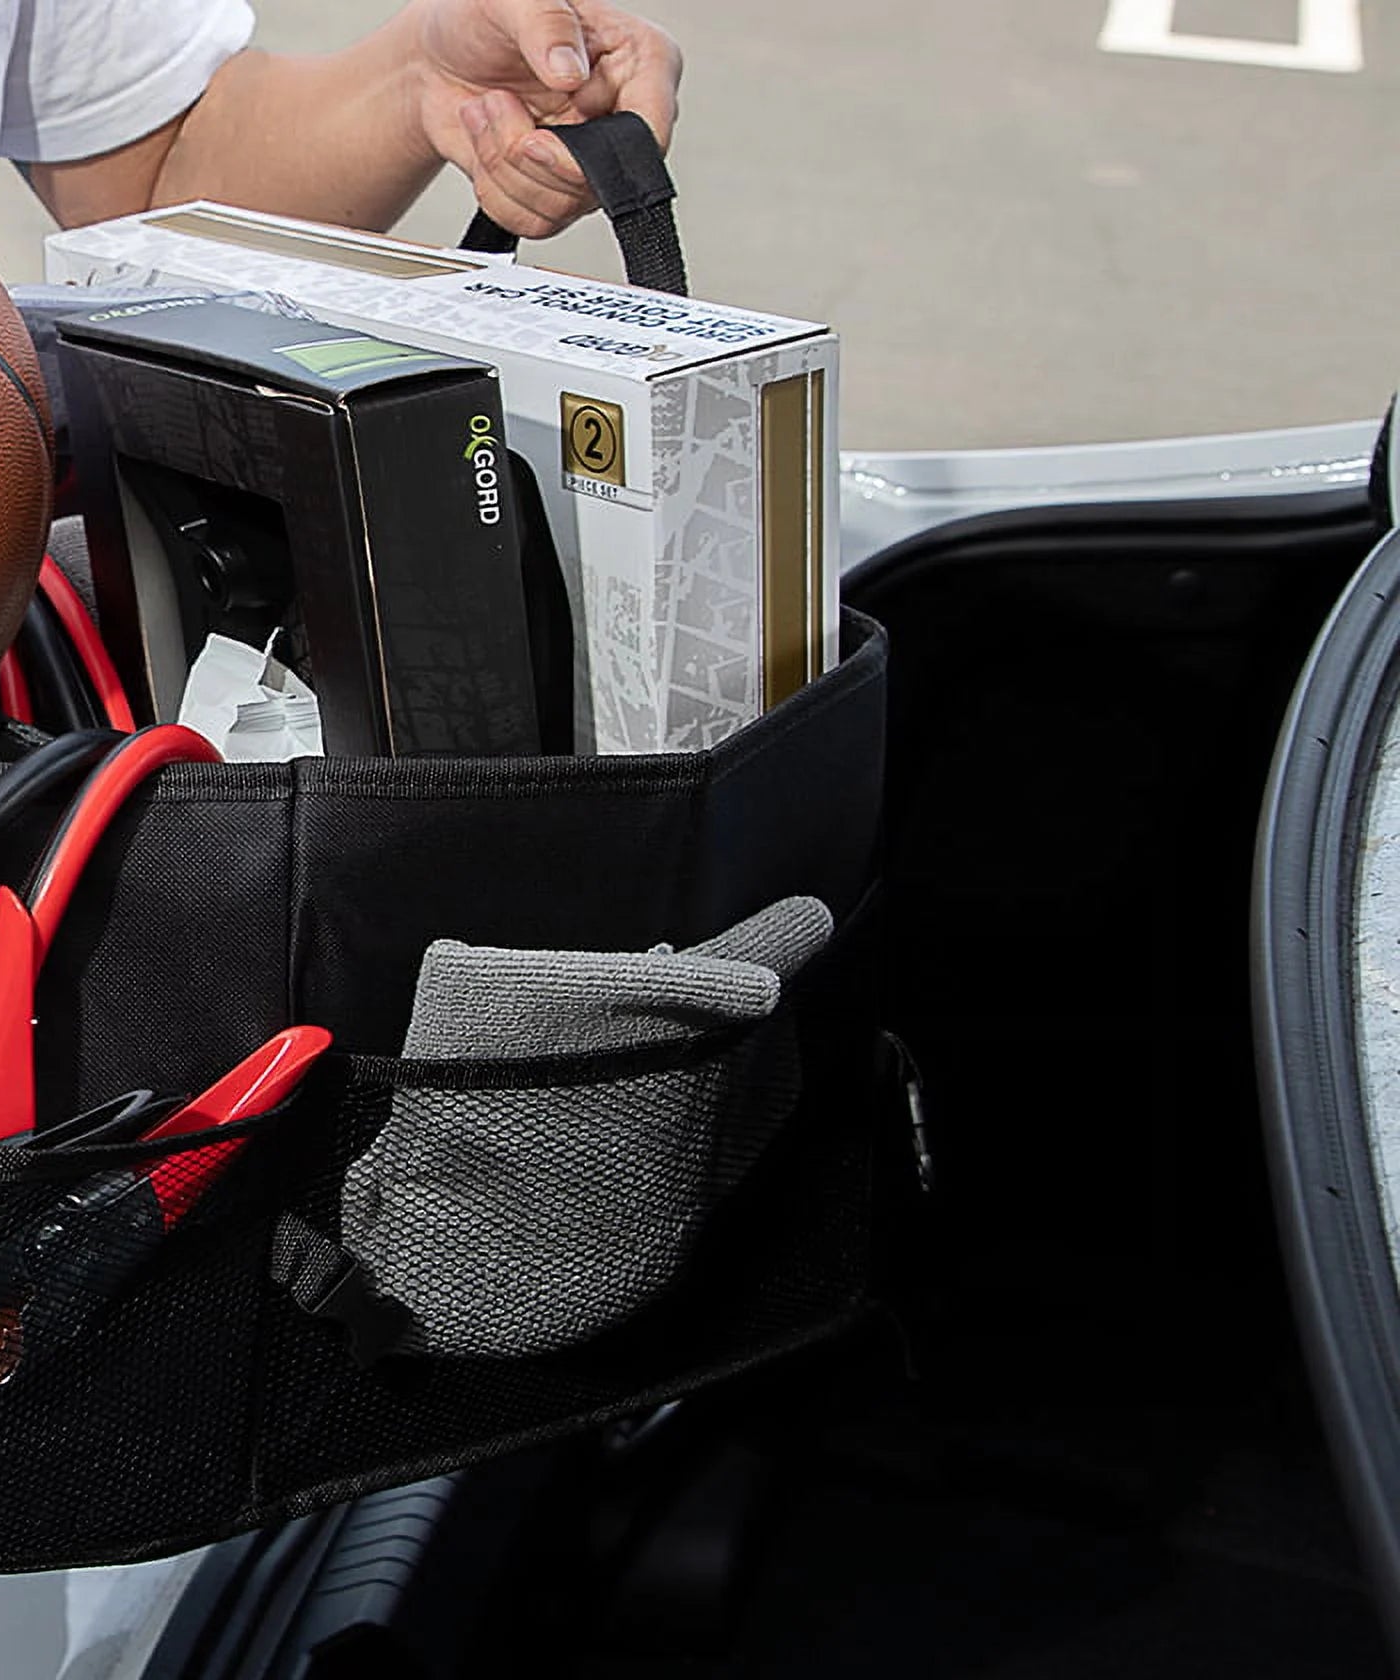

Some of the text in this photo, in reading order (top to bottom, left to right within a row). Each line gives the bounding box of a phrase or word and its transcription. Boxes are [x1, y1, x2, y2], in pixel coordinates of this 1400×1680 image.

[464, 282, 527, 299] CAR
[523, 284, 587, 300] SET
[534, 296, 665, 328] CONTROL
[586, 295, 689, 321] COVER
[667, 323, 746, 343] GRIP
[688, 316, 776, 336] SEAT
[583, 417, 604, 462] 2
[464, 415, 500, 525] OXGORD
